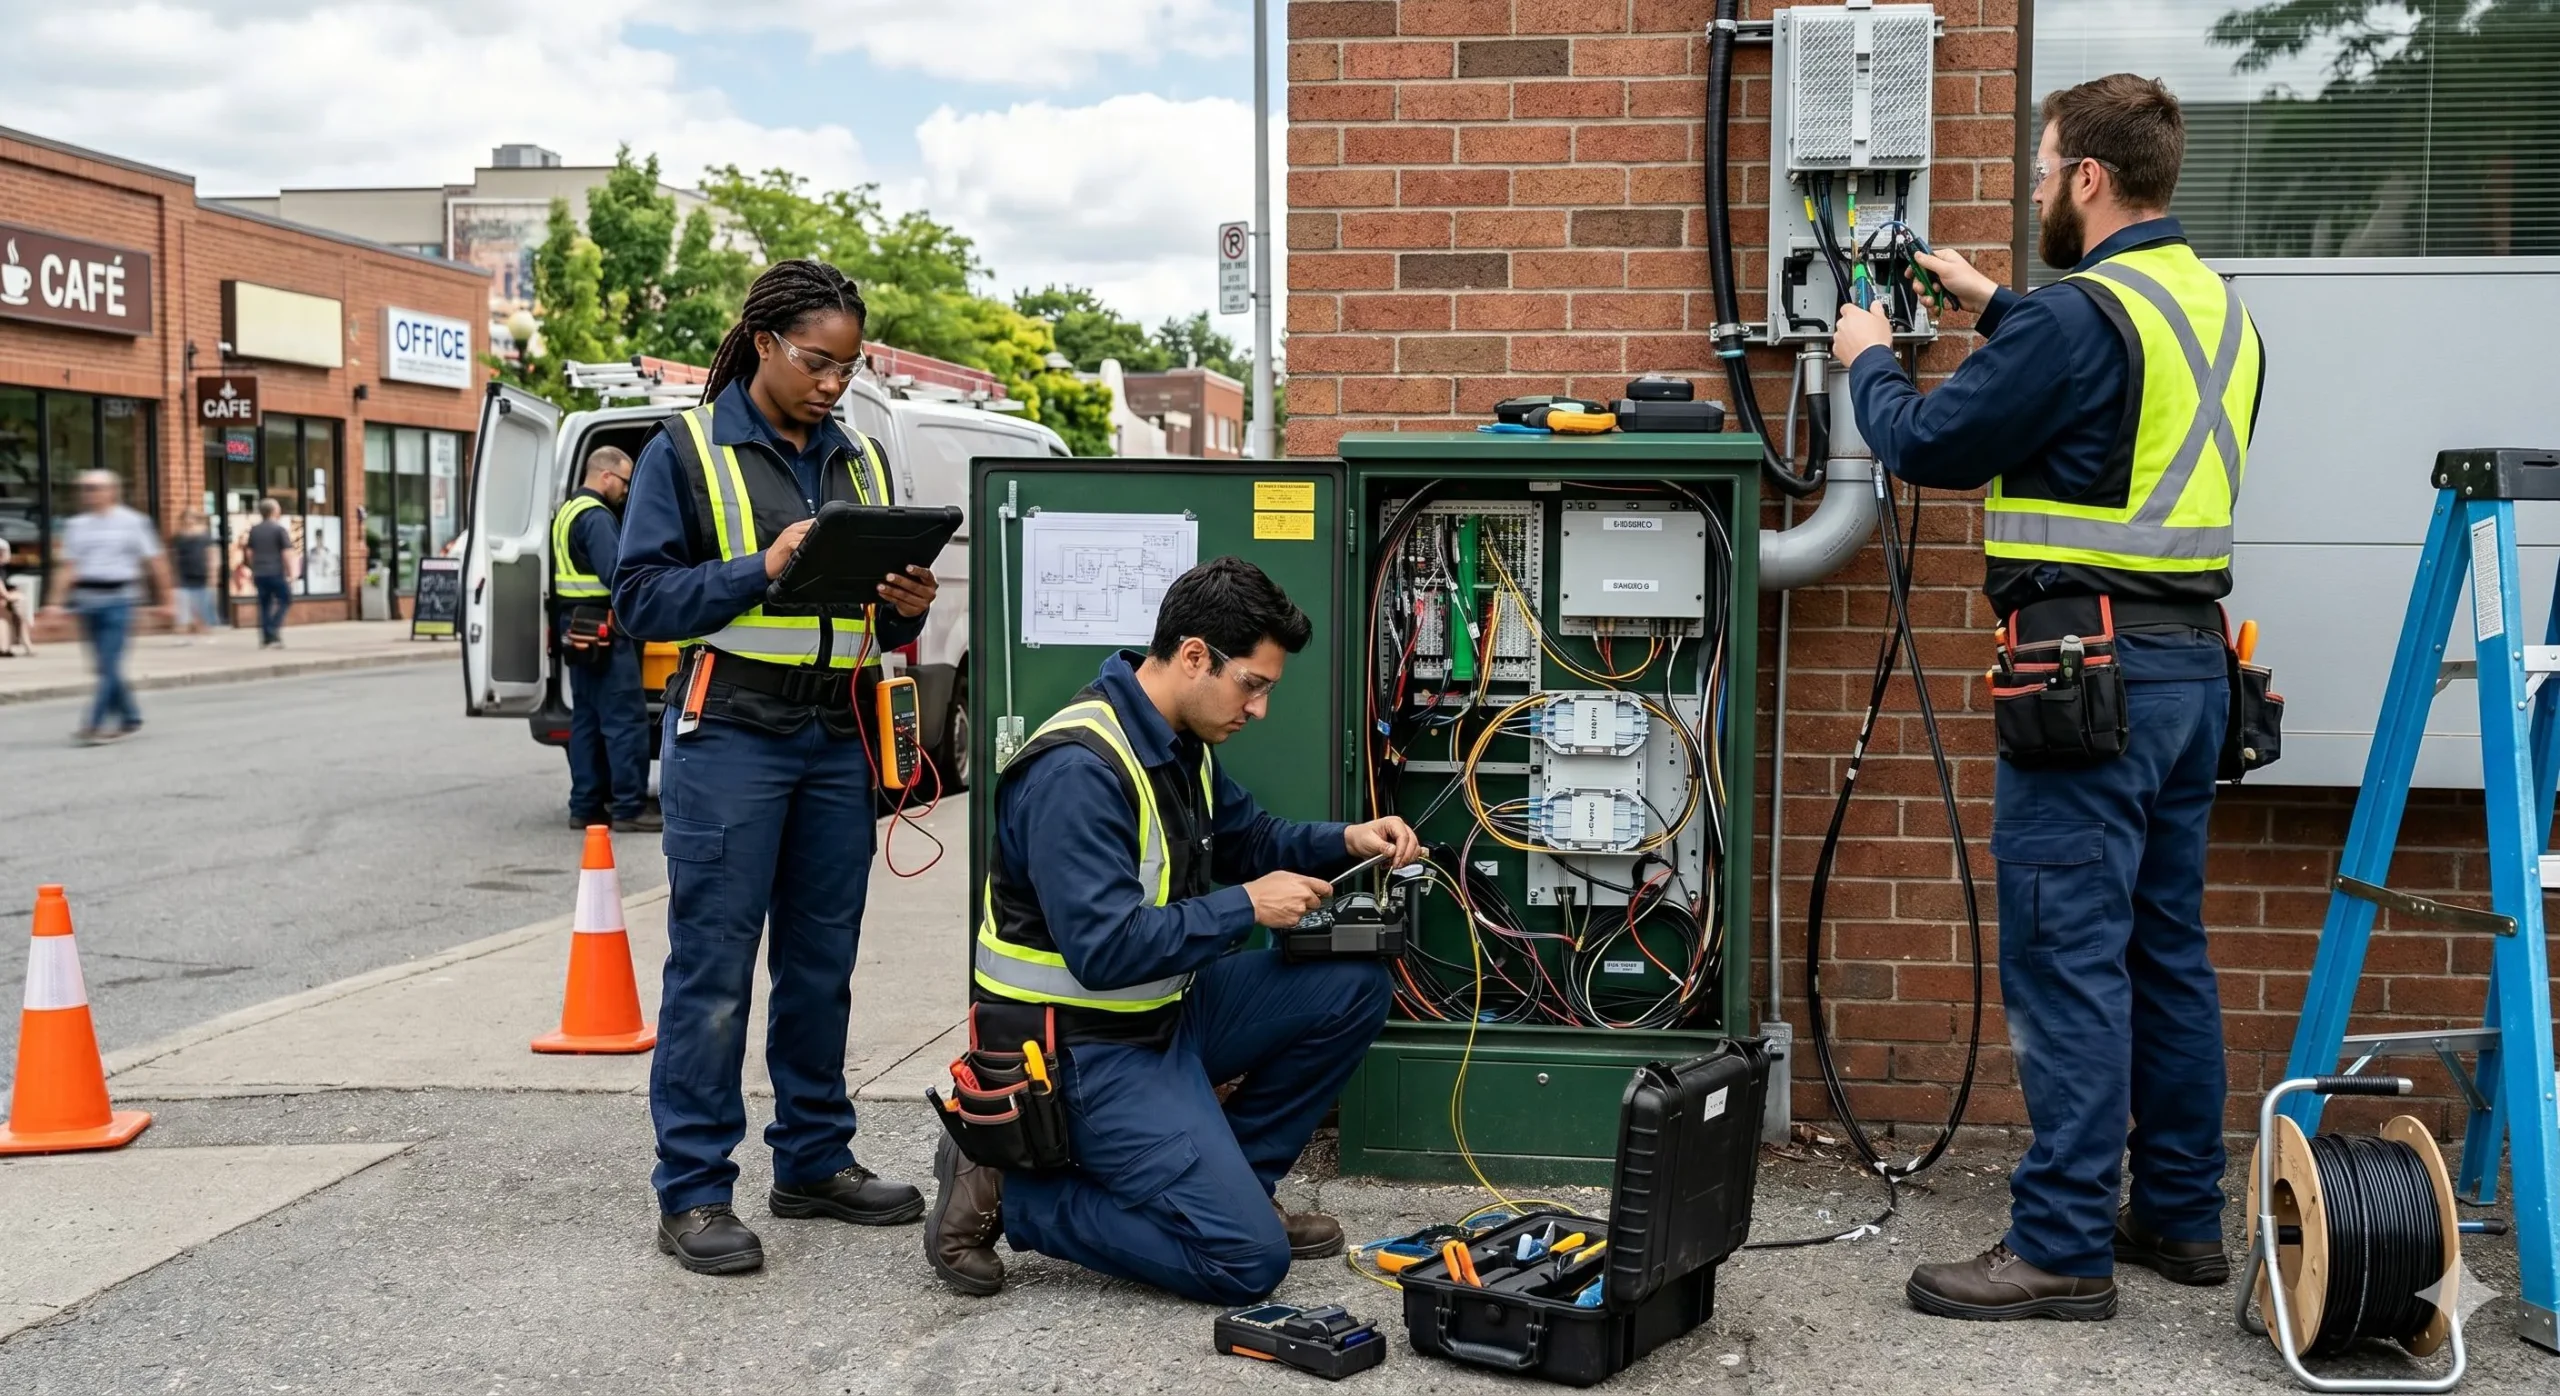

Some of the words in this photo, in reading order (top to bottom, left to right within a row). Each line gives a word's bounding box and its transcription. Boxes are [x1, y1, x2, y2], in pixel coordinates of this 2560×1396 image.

[40, 253, 127, 317] CAFÉ
[396, 320, 465, 360] OFFICE
[202, 399, 252, 419] CAFE
